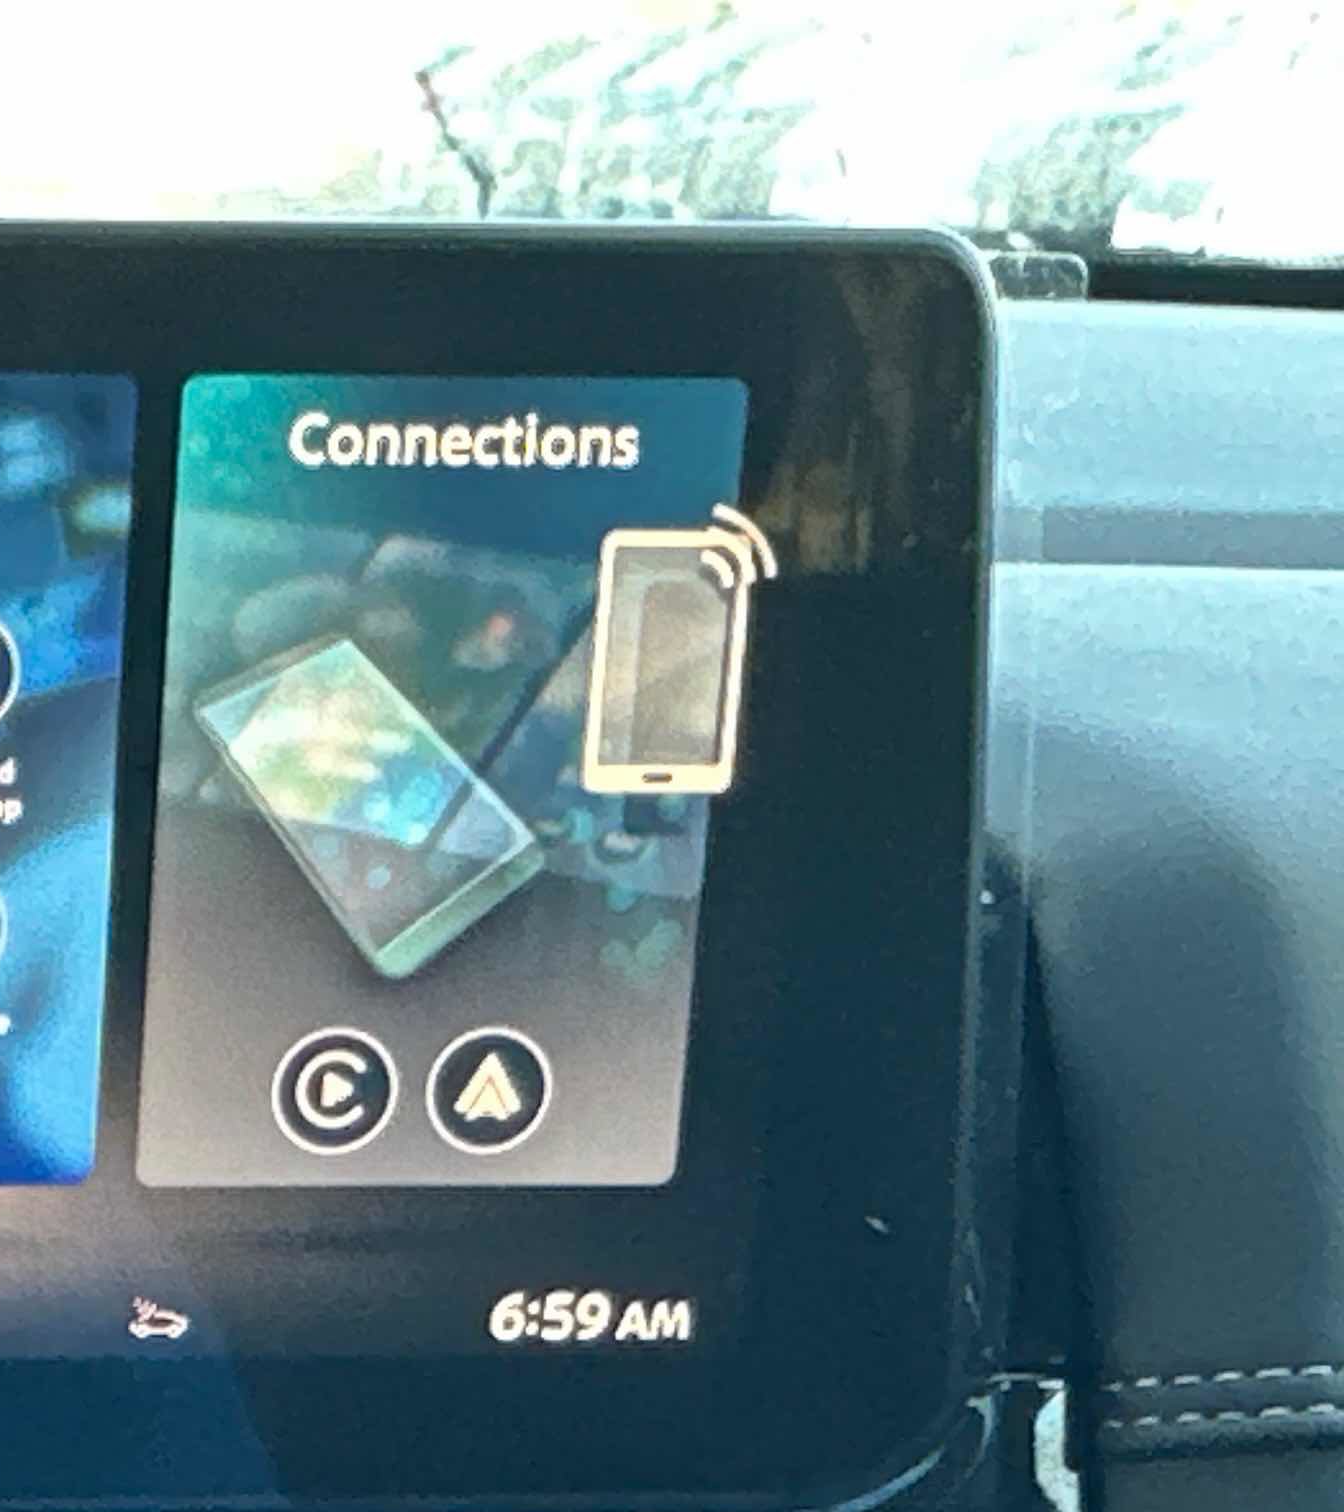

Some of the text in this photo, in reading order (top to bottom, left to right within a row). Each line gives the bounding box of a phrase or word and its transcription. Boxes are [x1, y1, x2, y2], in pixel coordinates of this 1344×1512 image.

[289, 413, 640, 470] Connections
[489, 1290, 690, 1341] 6:59 AM
